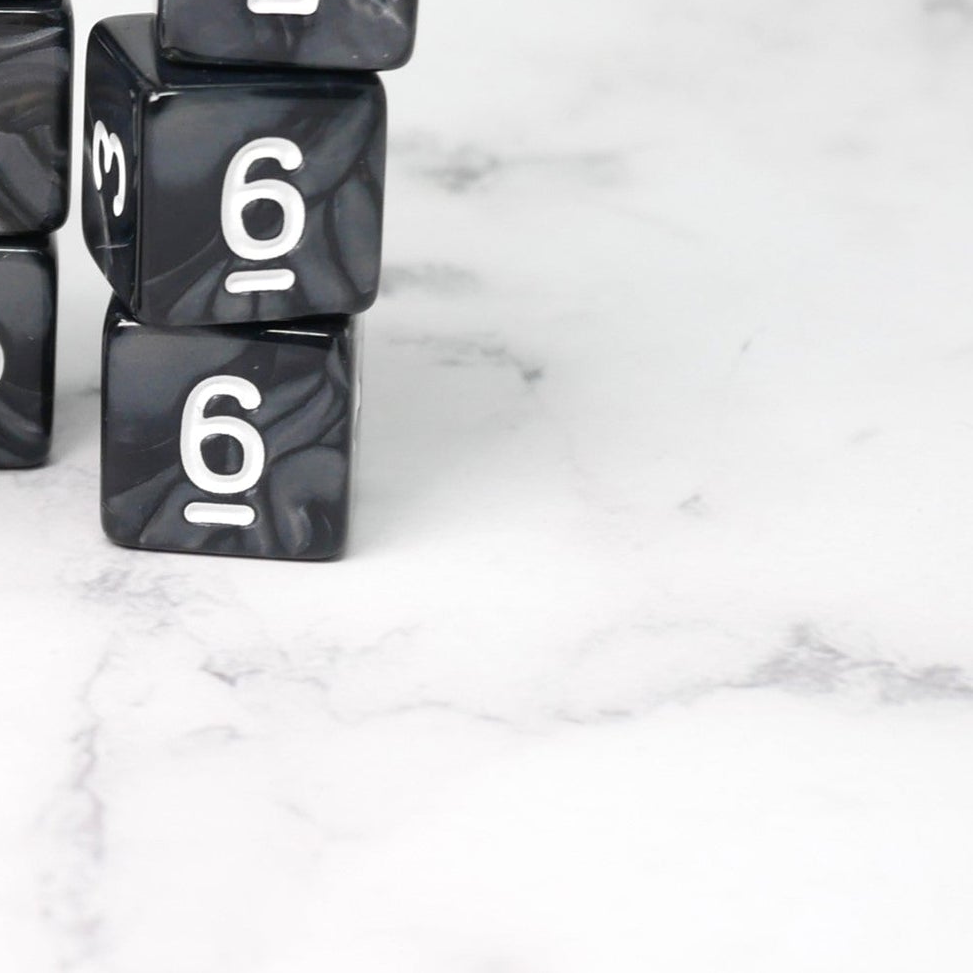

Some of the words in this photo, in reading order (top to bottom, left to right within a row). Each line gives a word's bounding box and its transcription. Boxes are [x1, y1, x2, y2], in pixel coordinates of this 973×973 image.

[92, 120, 126, 217] 3
[220, 136, 306, 295] 6
[179, 374, 267, 527] 6
